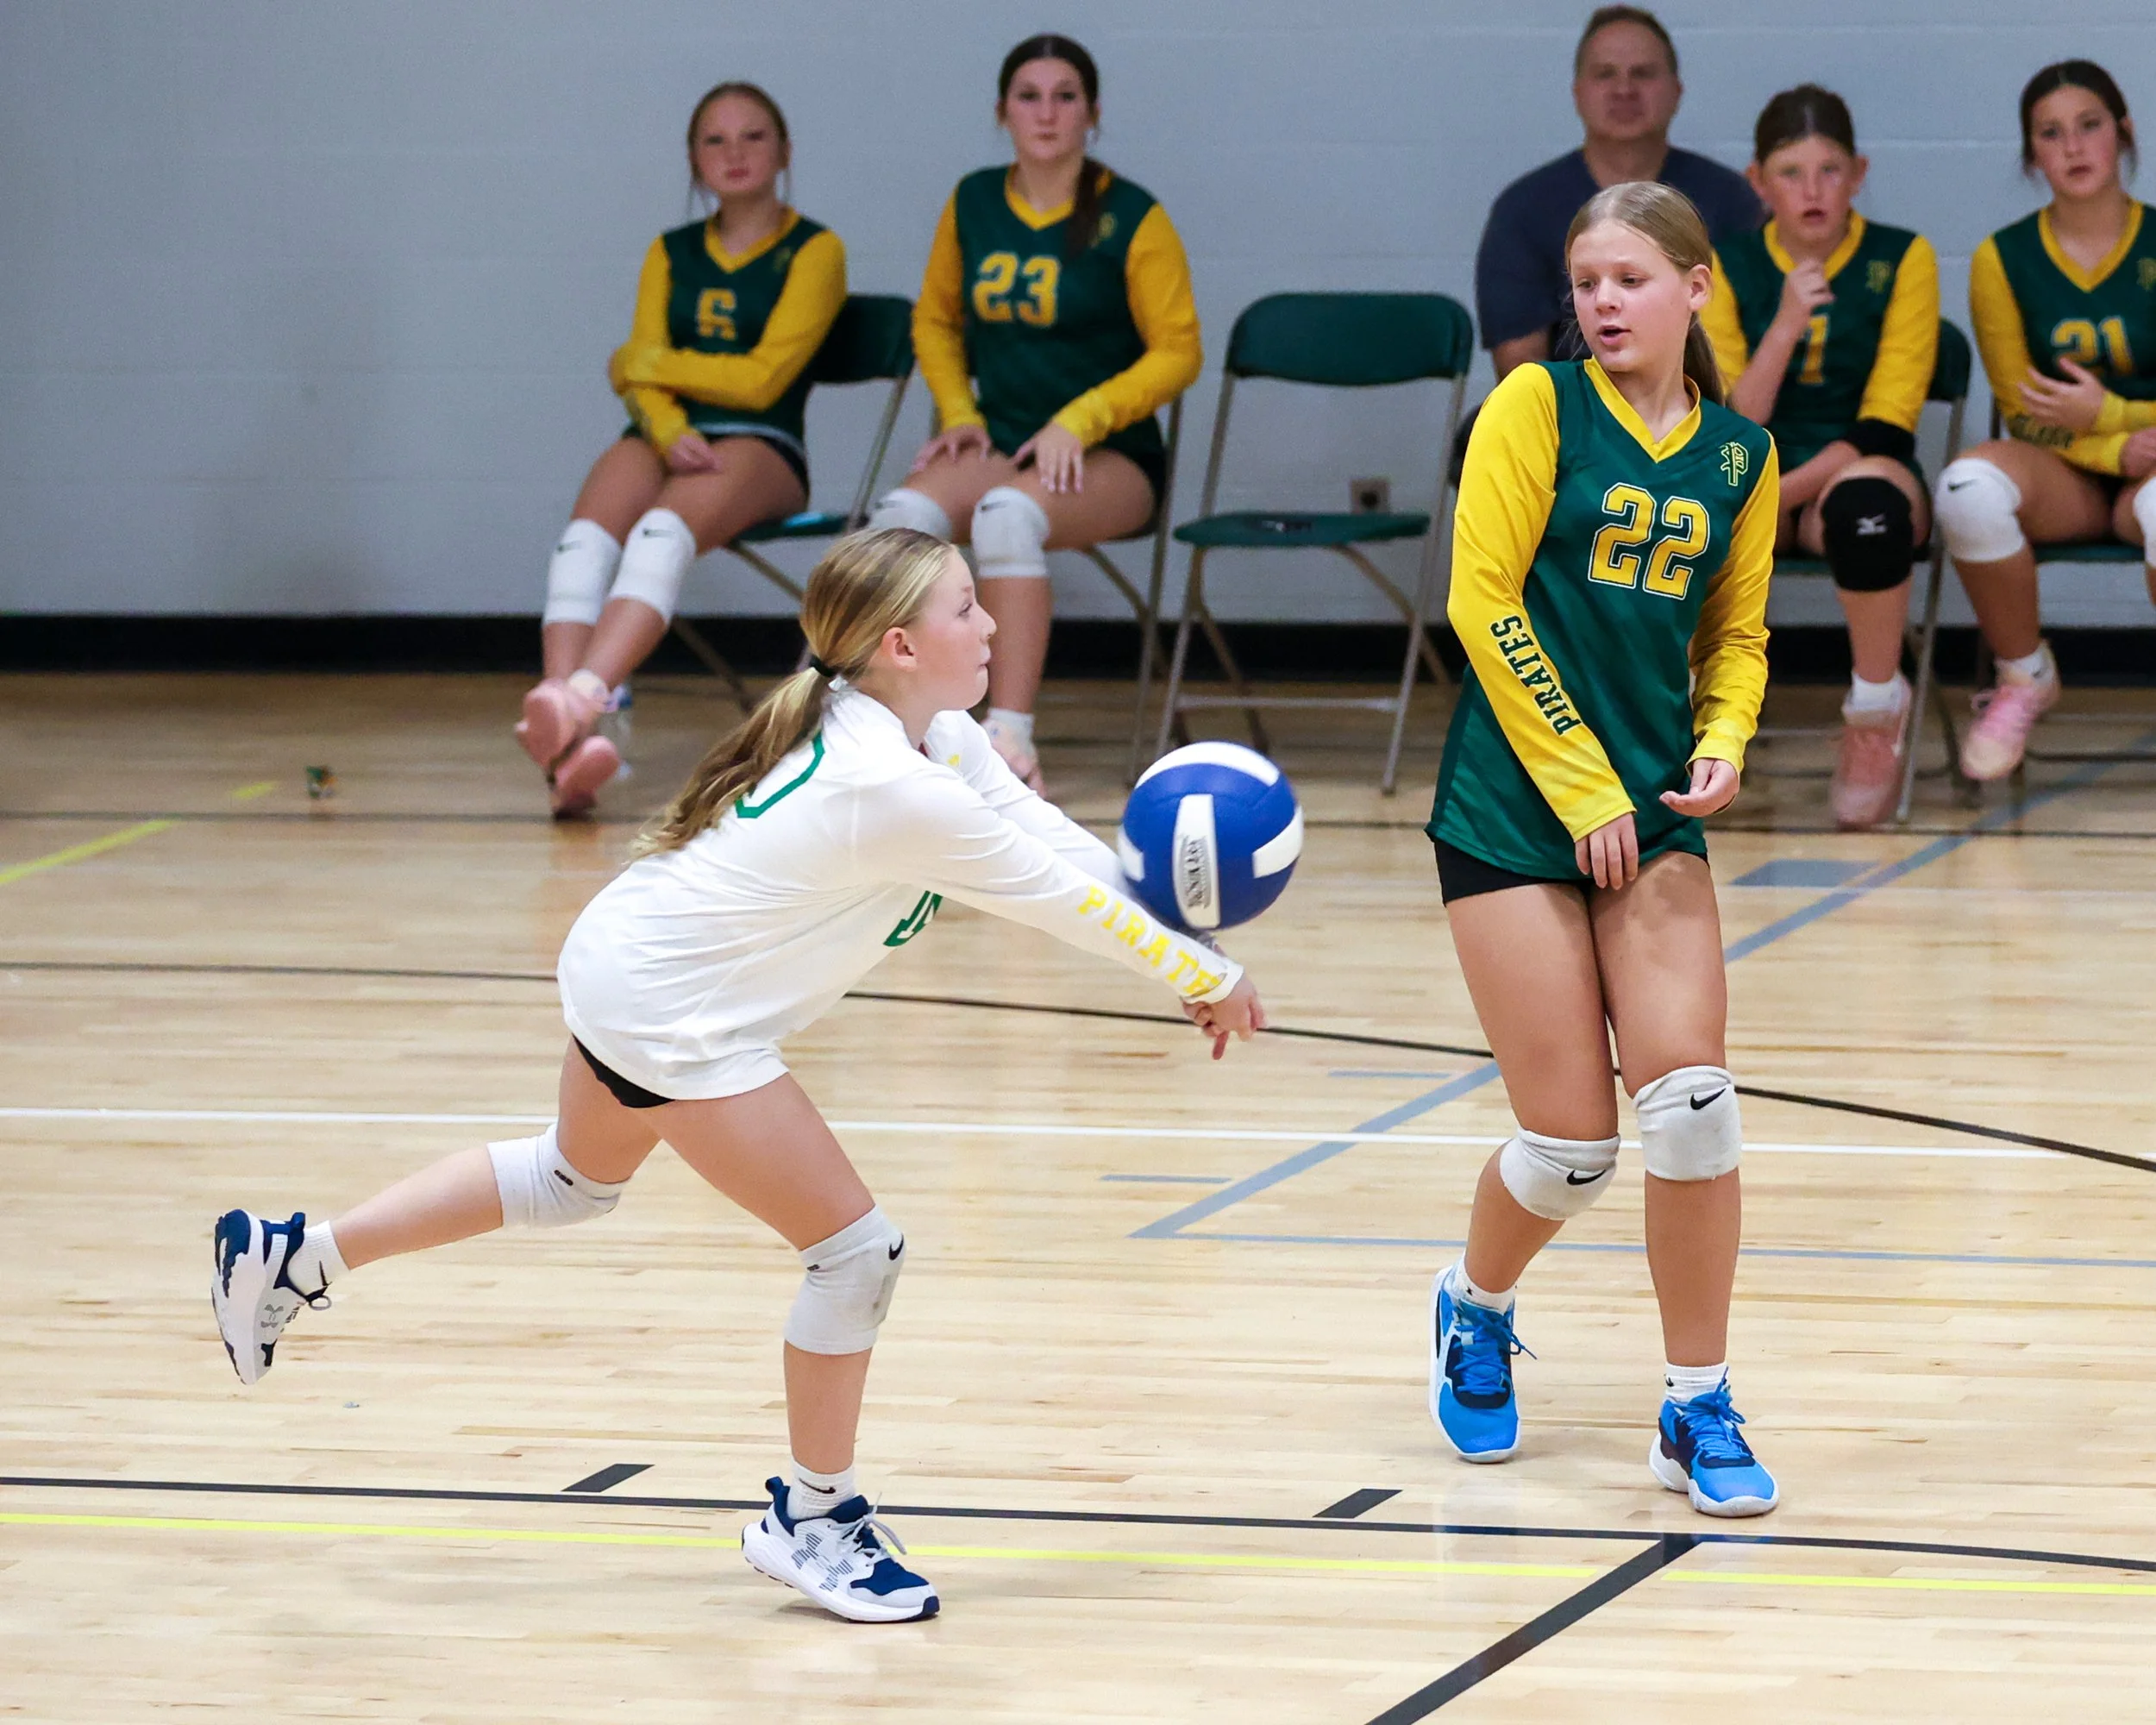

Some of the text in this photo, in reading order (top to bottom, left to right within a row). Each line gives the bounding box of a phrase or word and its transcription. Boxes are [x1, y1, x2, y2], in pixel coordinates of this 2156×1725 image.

[972, 250, 1061, 327] 23
[2050, 315, 2135, 378] 21
[1588, 482, 1709, 600] 22
[1490, 615, 1583, 737] PIRATES
